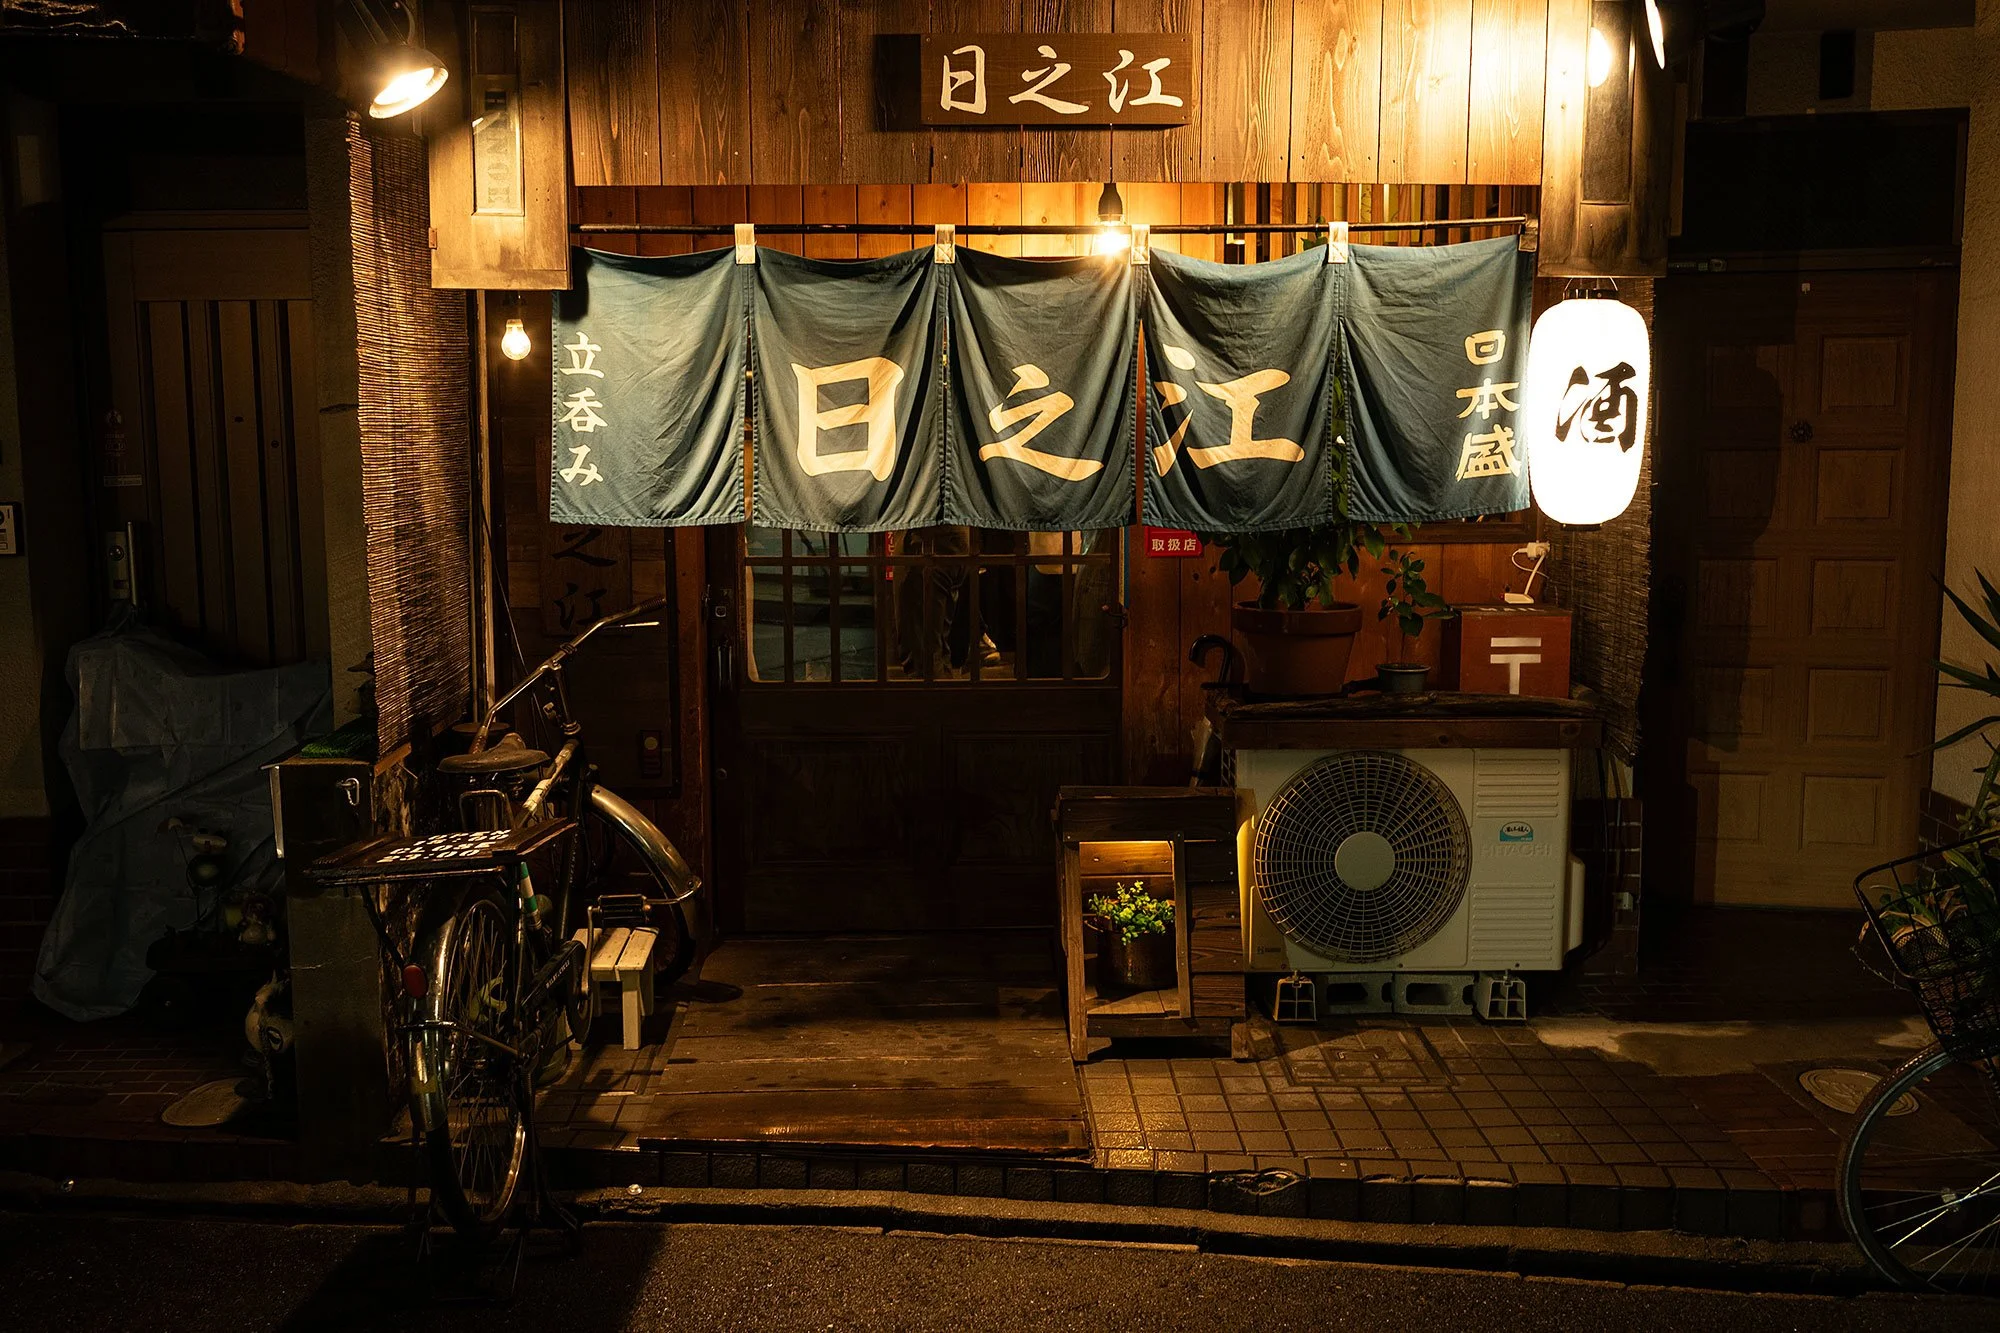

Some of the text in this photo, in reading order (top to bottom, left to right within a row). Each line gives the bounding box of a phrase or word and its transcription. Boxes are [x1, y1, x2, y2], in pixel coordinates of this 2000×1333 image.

[940, 44, 1184, 114] 日之江
[558, 331, 608, 486] 立呑み
[790, 344, 1305, 481] 日之江
[1455, 329, 1520, 482] 日本盛
[1555, 361, 1638, 453] 酒
[1151, 538, 1196, 551] 取扱店
[376, 850, 480, 863] 23:00
[390, 841, 496, 854] CLOSE
[428, 829, 511, 840] OPEN
